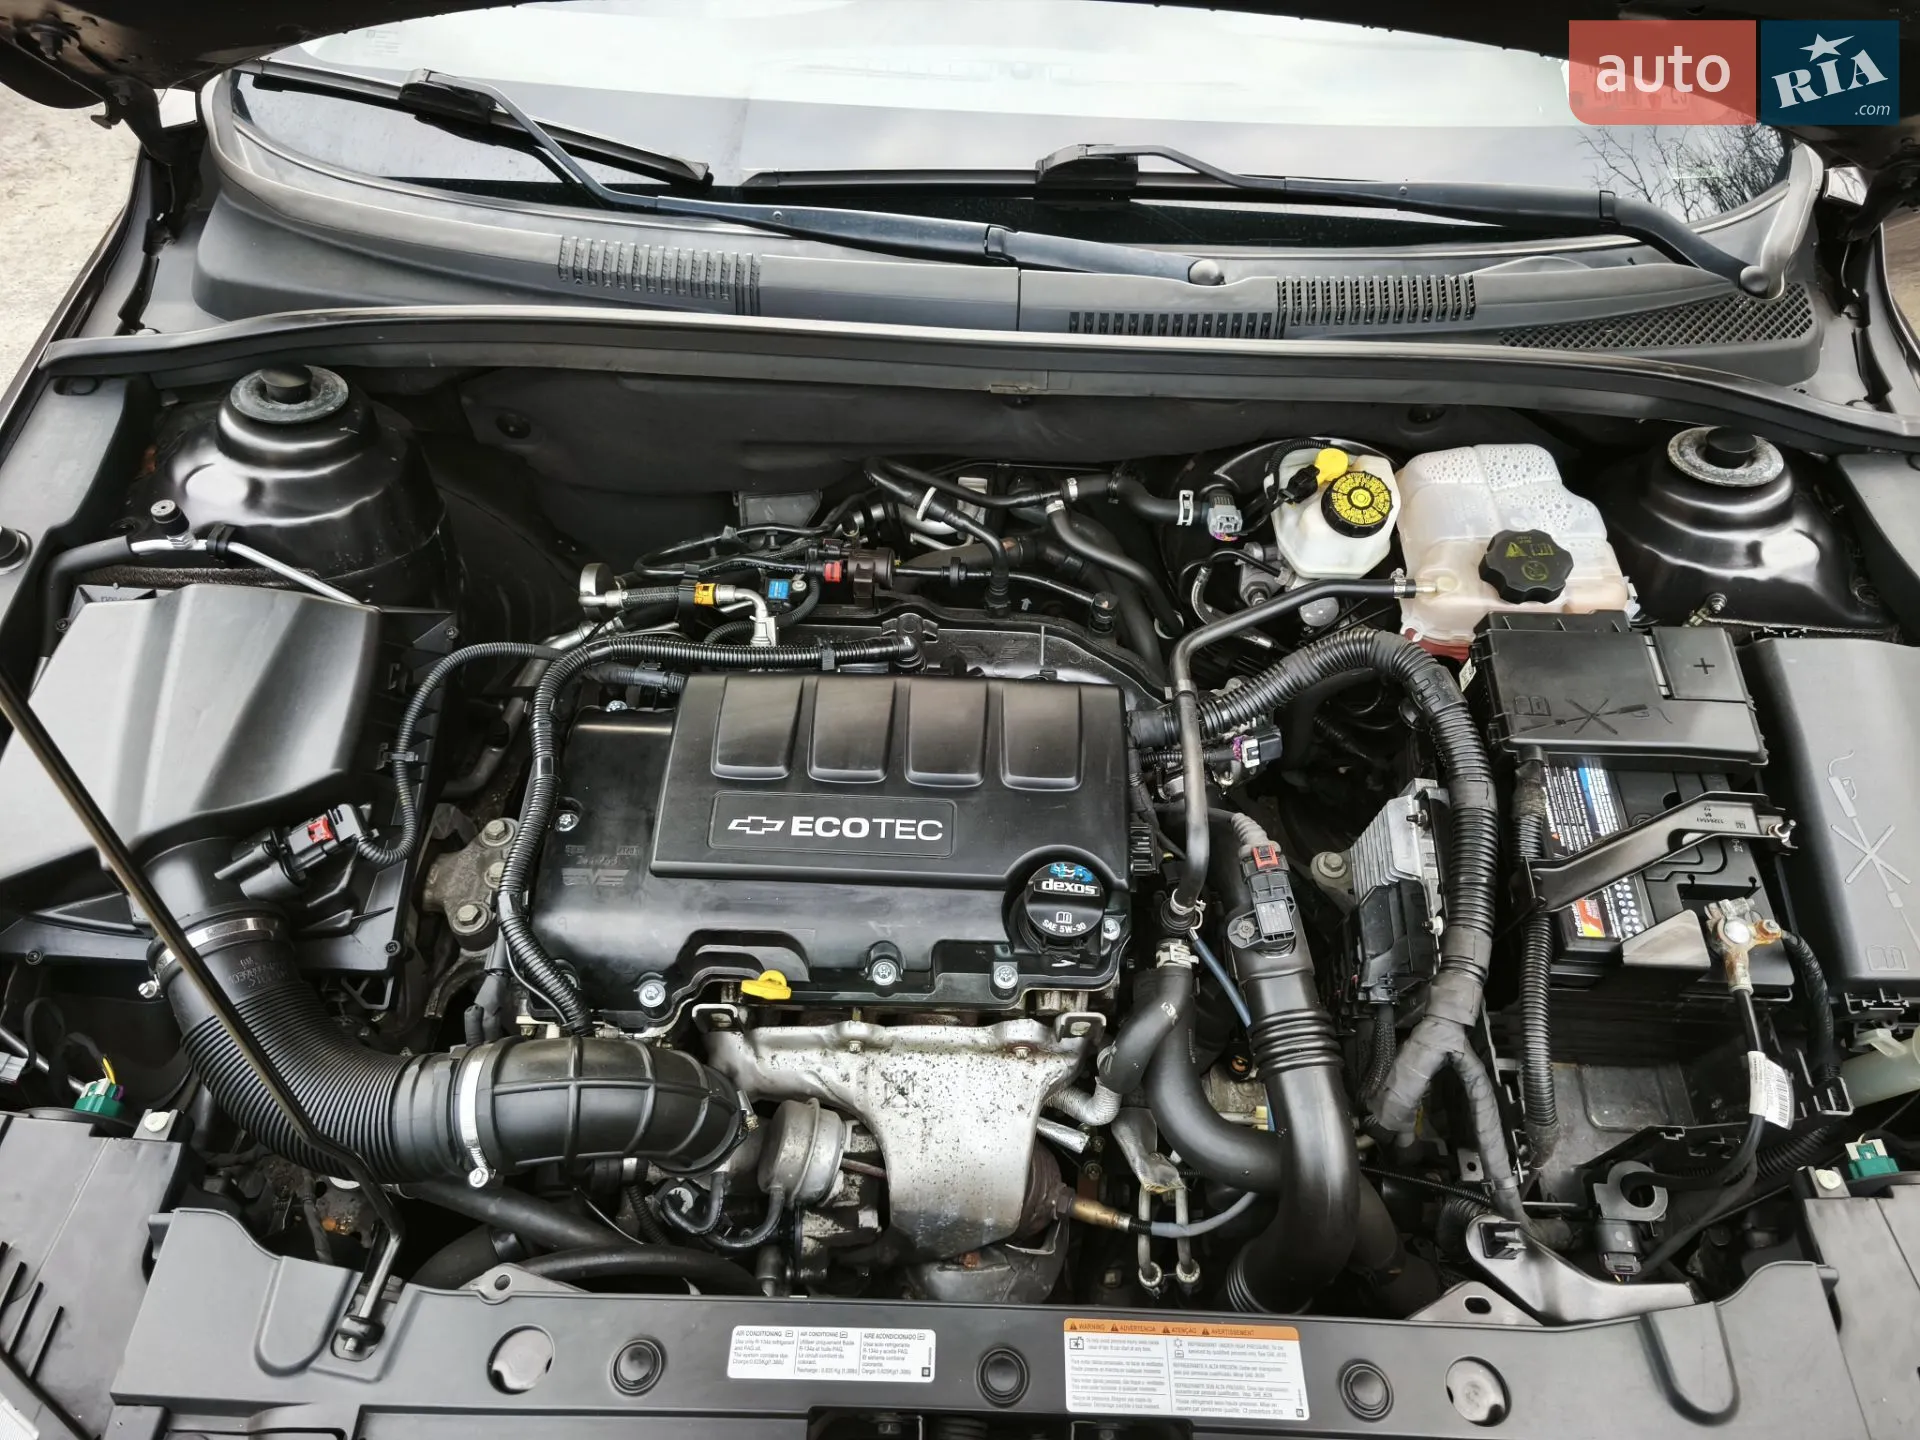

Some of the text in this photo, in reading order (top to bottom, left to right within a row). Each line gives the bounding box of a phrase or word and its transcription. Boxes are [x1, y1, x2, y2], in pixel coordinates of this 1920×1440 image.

[791, 815, 943, 841] ECOTEC
[1042, 878, 1098, 895] dexos
[1042, 919, 1087, 934] SAE 5W-30
